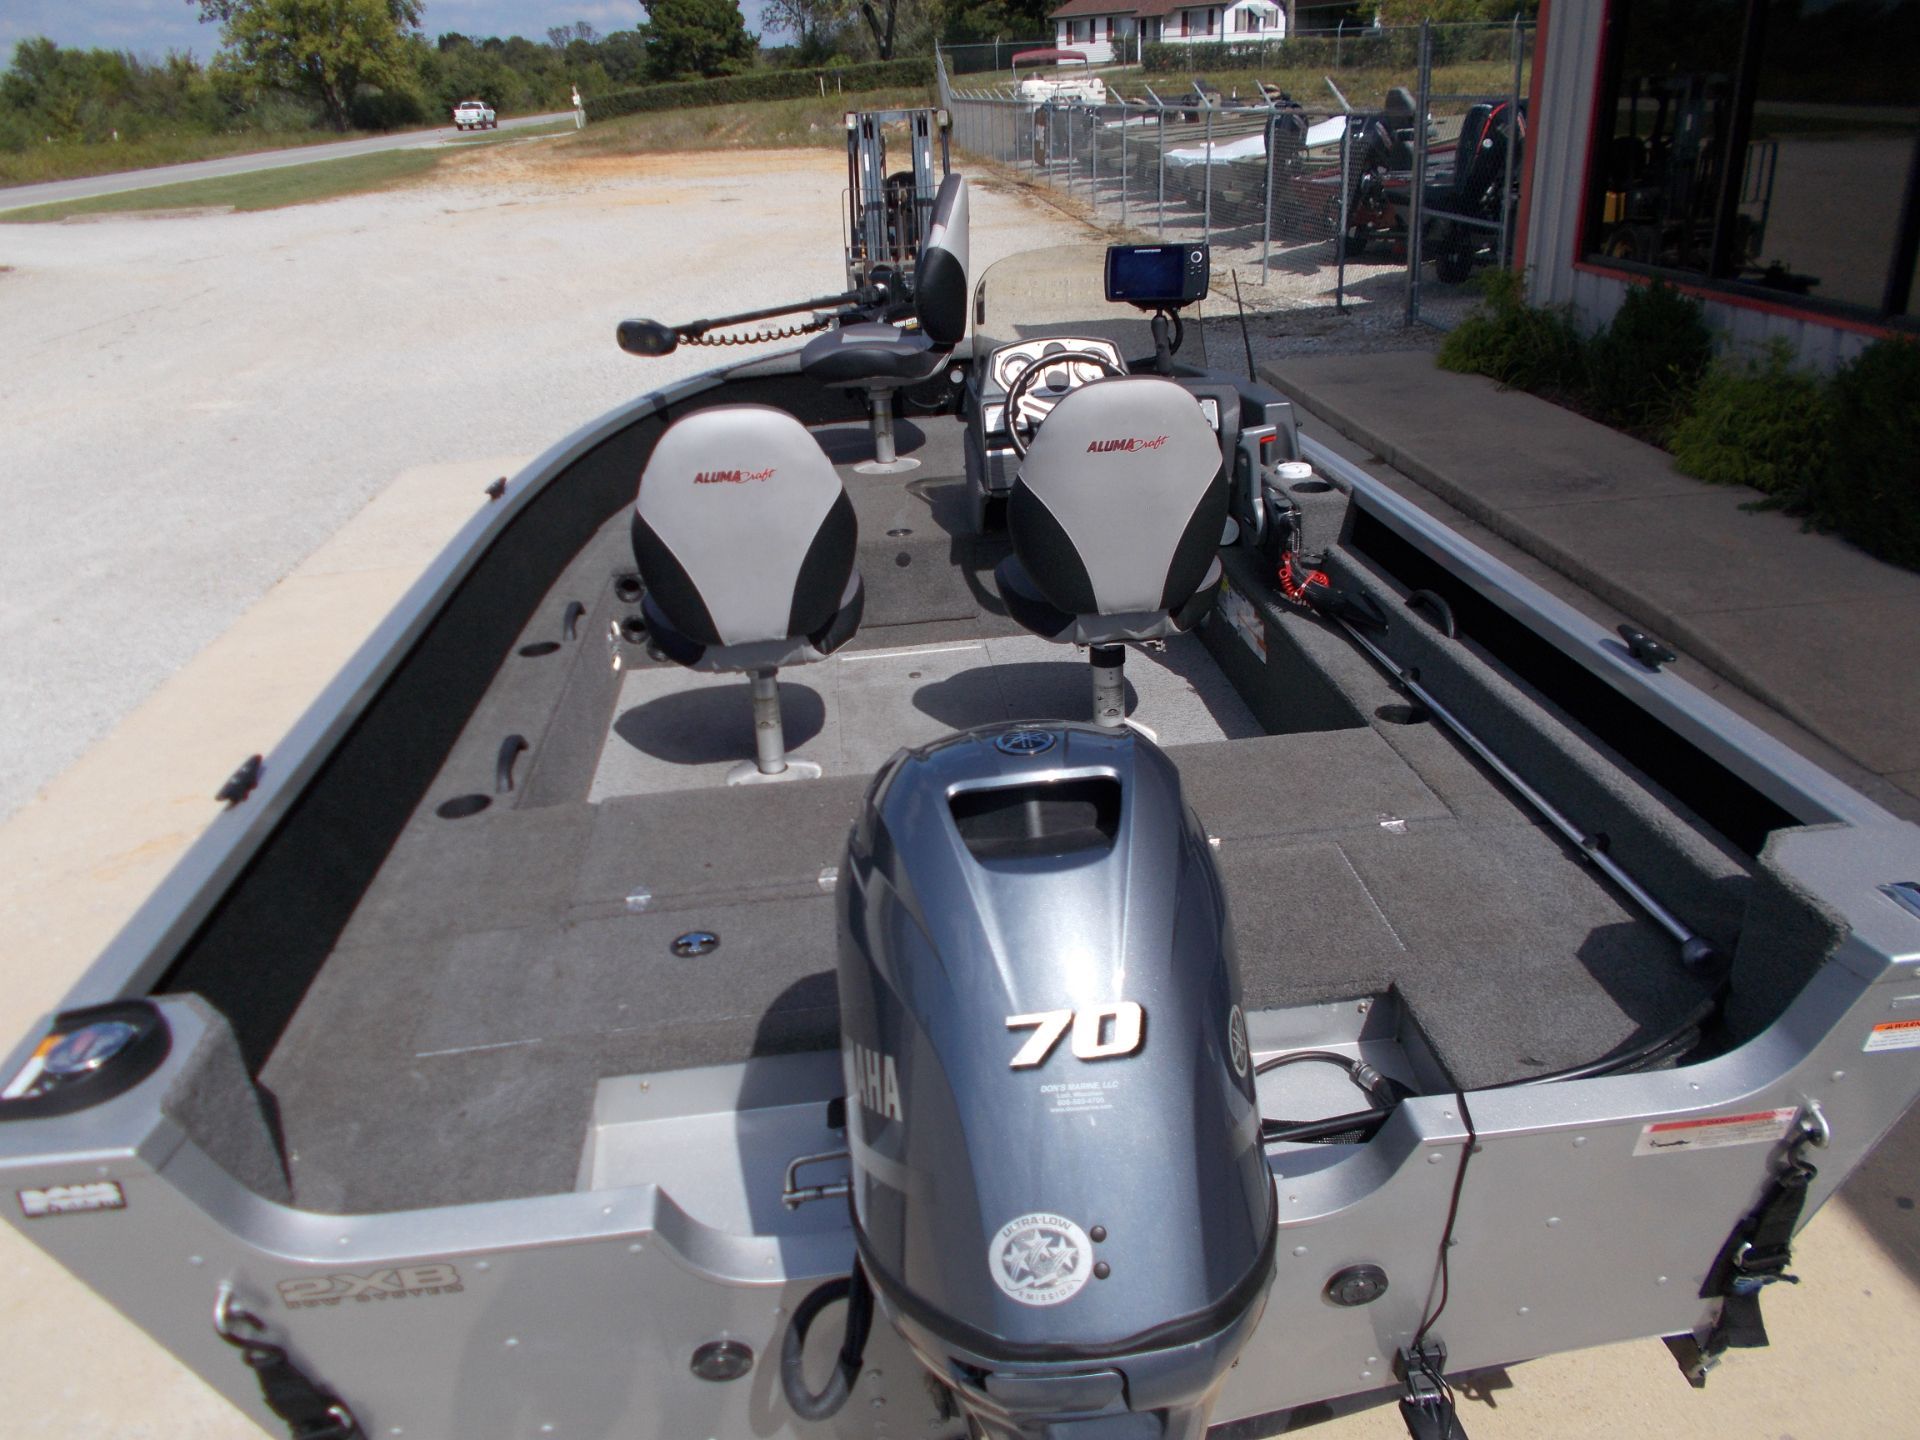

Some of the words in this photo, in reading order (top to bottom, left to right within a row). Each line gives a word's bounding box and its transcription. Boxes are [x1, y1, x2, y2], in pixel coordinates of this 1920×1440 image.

[1005, 1001, 1147, 1070] 70
[1068, 1081, 1101, 1090] MARINE
[1102, 1080, 1119, 1089] LLC
[1002, 1215, 1073, 1239] ULTRA-LOW
[276, 1263, 461, 1300] 2XB
